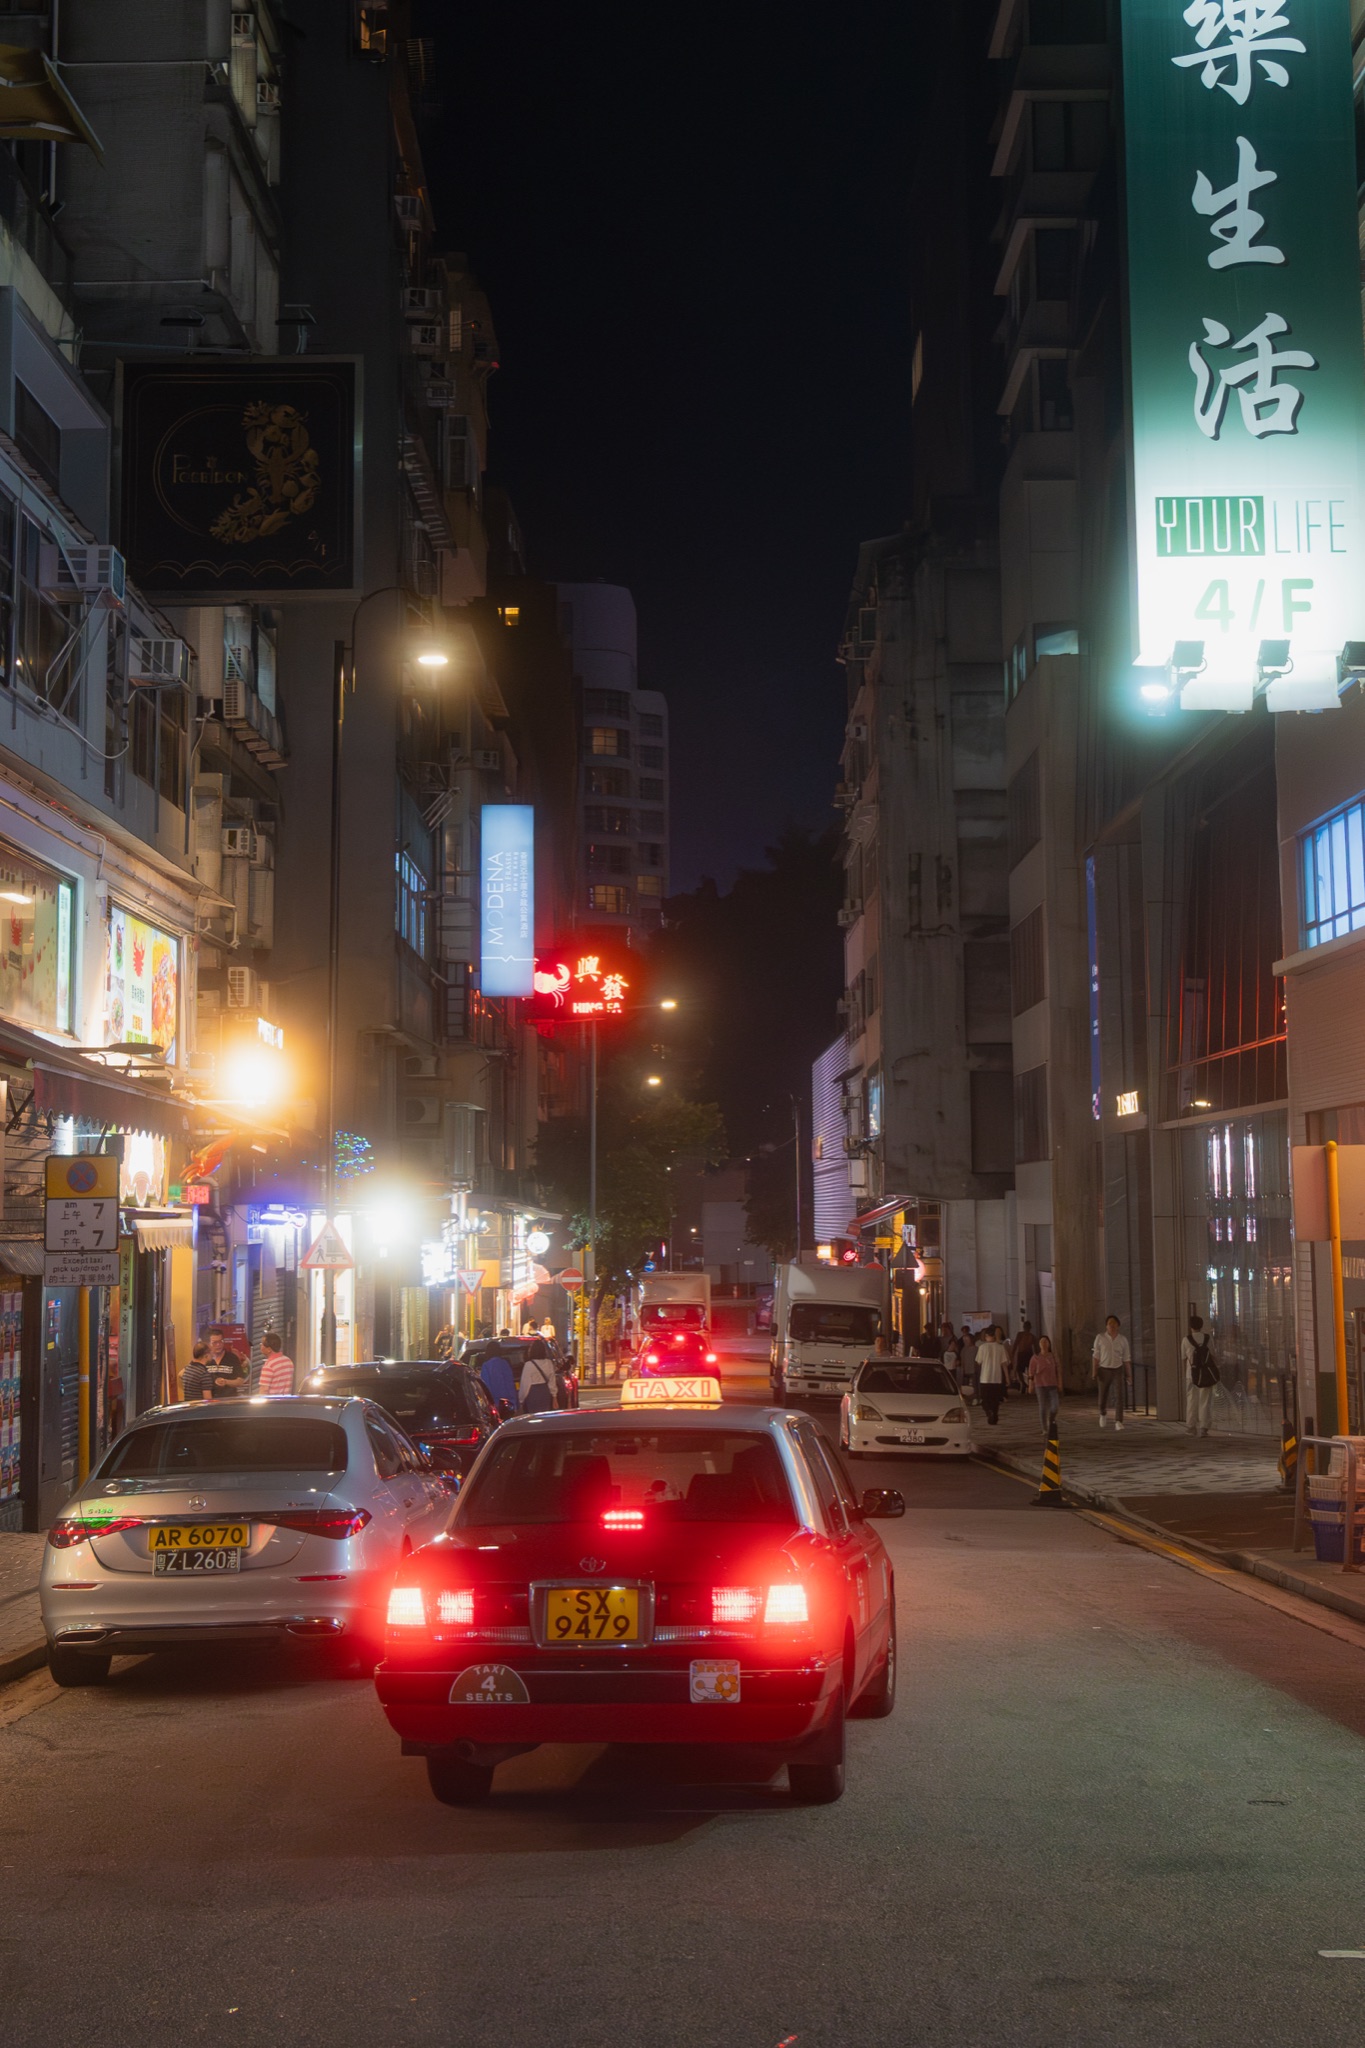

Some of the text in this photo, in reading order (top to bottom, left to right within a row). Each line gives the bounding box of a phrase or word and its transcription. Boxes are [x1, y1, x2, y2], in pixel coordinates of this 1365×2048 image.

[1159, 499, 1347, 553] YOUR LIFE
[1194, 578, 1314, 633] 4/F
[487, 851, 504, 946] MODENA
[61, 1211, 81, 1220] 上午
[93, 1203, 104, 1219] 7
[60, 1238, 81, 1248] 下午
[64, 1229, 104, 1247] pm 7
[62, 1257, 89, 1265] Except
[629, 1380, 711, 1399] TAXI
[155, 1527, 243, 1547] AR 6070
[575, 1591, 611, 1614] SX
[555, 1615, 630, 1638] 9479
[473, 1665, 505, 1676] TAXI
[481, 1675, 496, 1692] 4
[466, 1693, 513, 1702] SEATS
